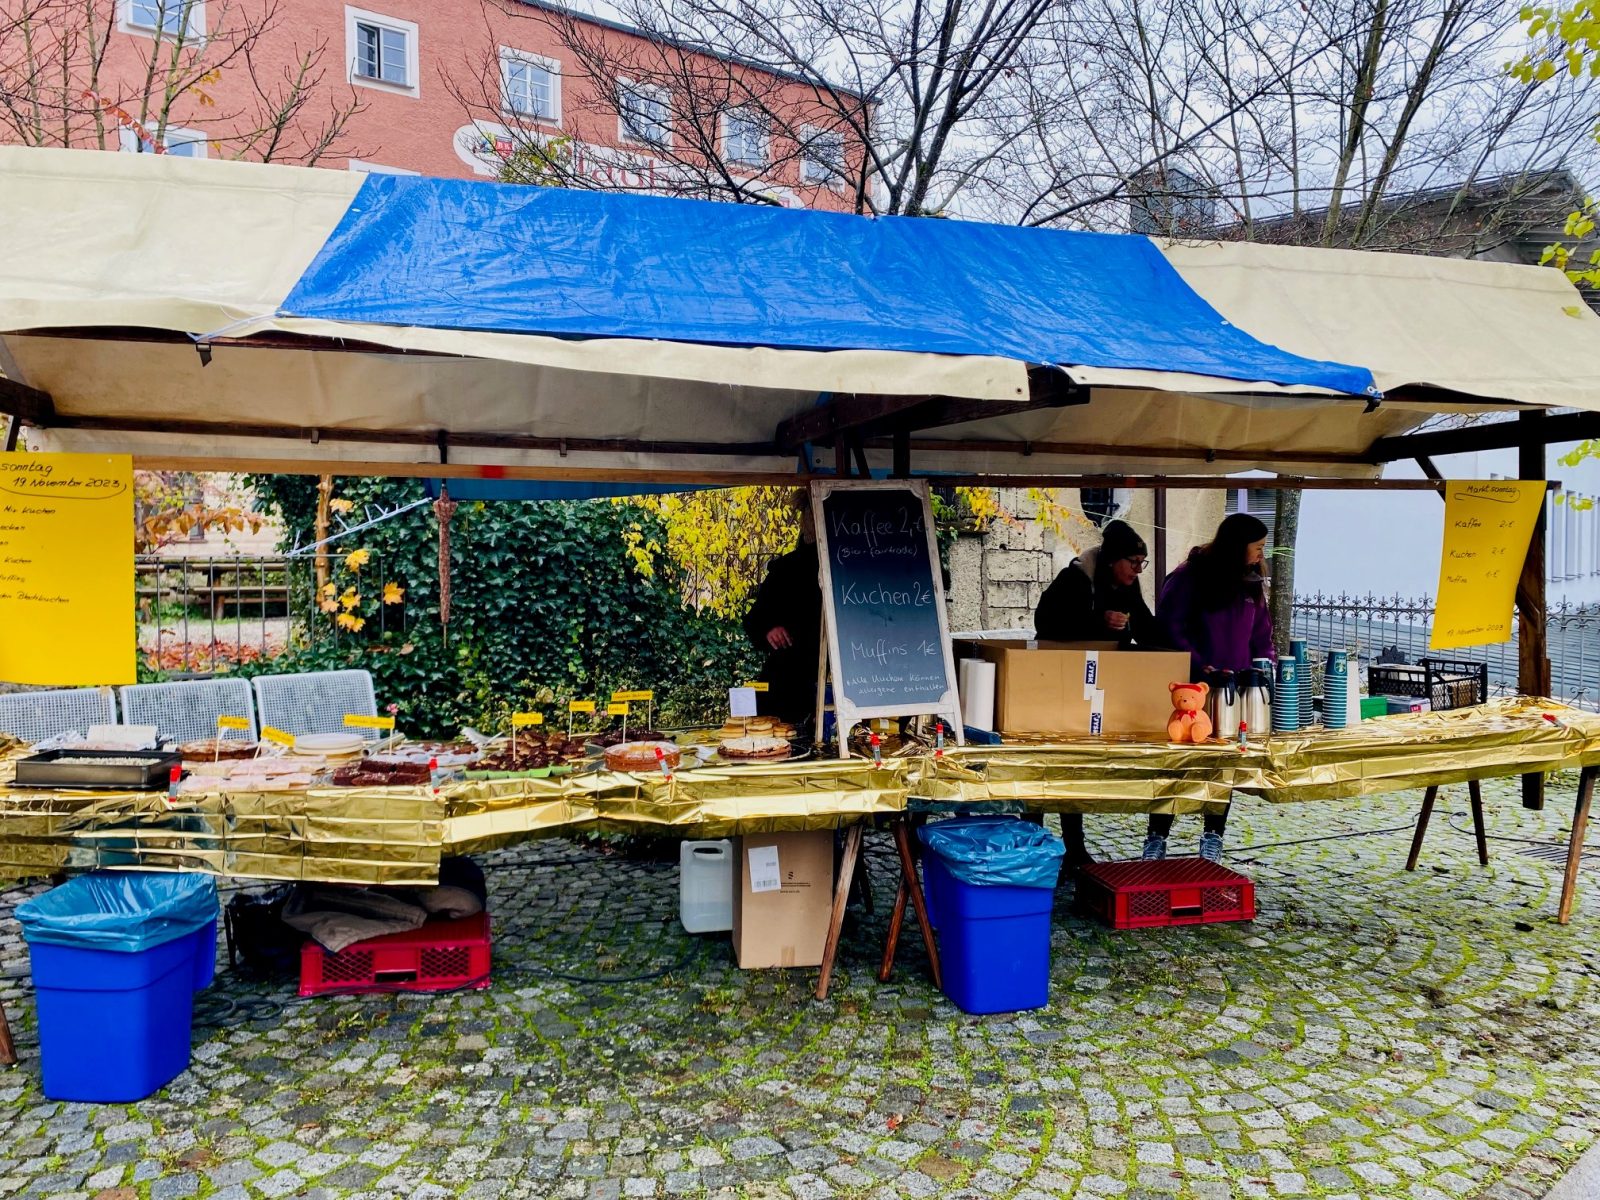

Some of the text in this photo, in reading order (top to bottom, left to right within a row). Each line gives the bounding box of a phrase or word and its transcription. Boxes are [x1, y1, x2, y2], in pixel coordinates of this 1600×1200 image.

[12, 477, 120, 489] 19 November 2023
[832, 509, 894, 548] Kaffee
[1455, 517, 1482, 528] Kaffee
[842, 581, 932, 606] Kuchen 2€
[851, 639, 937, 666] Muffins 1€
